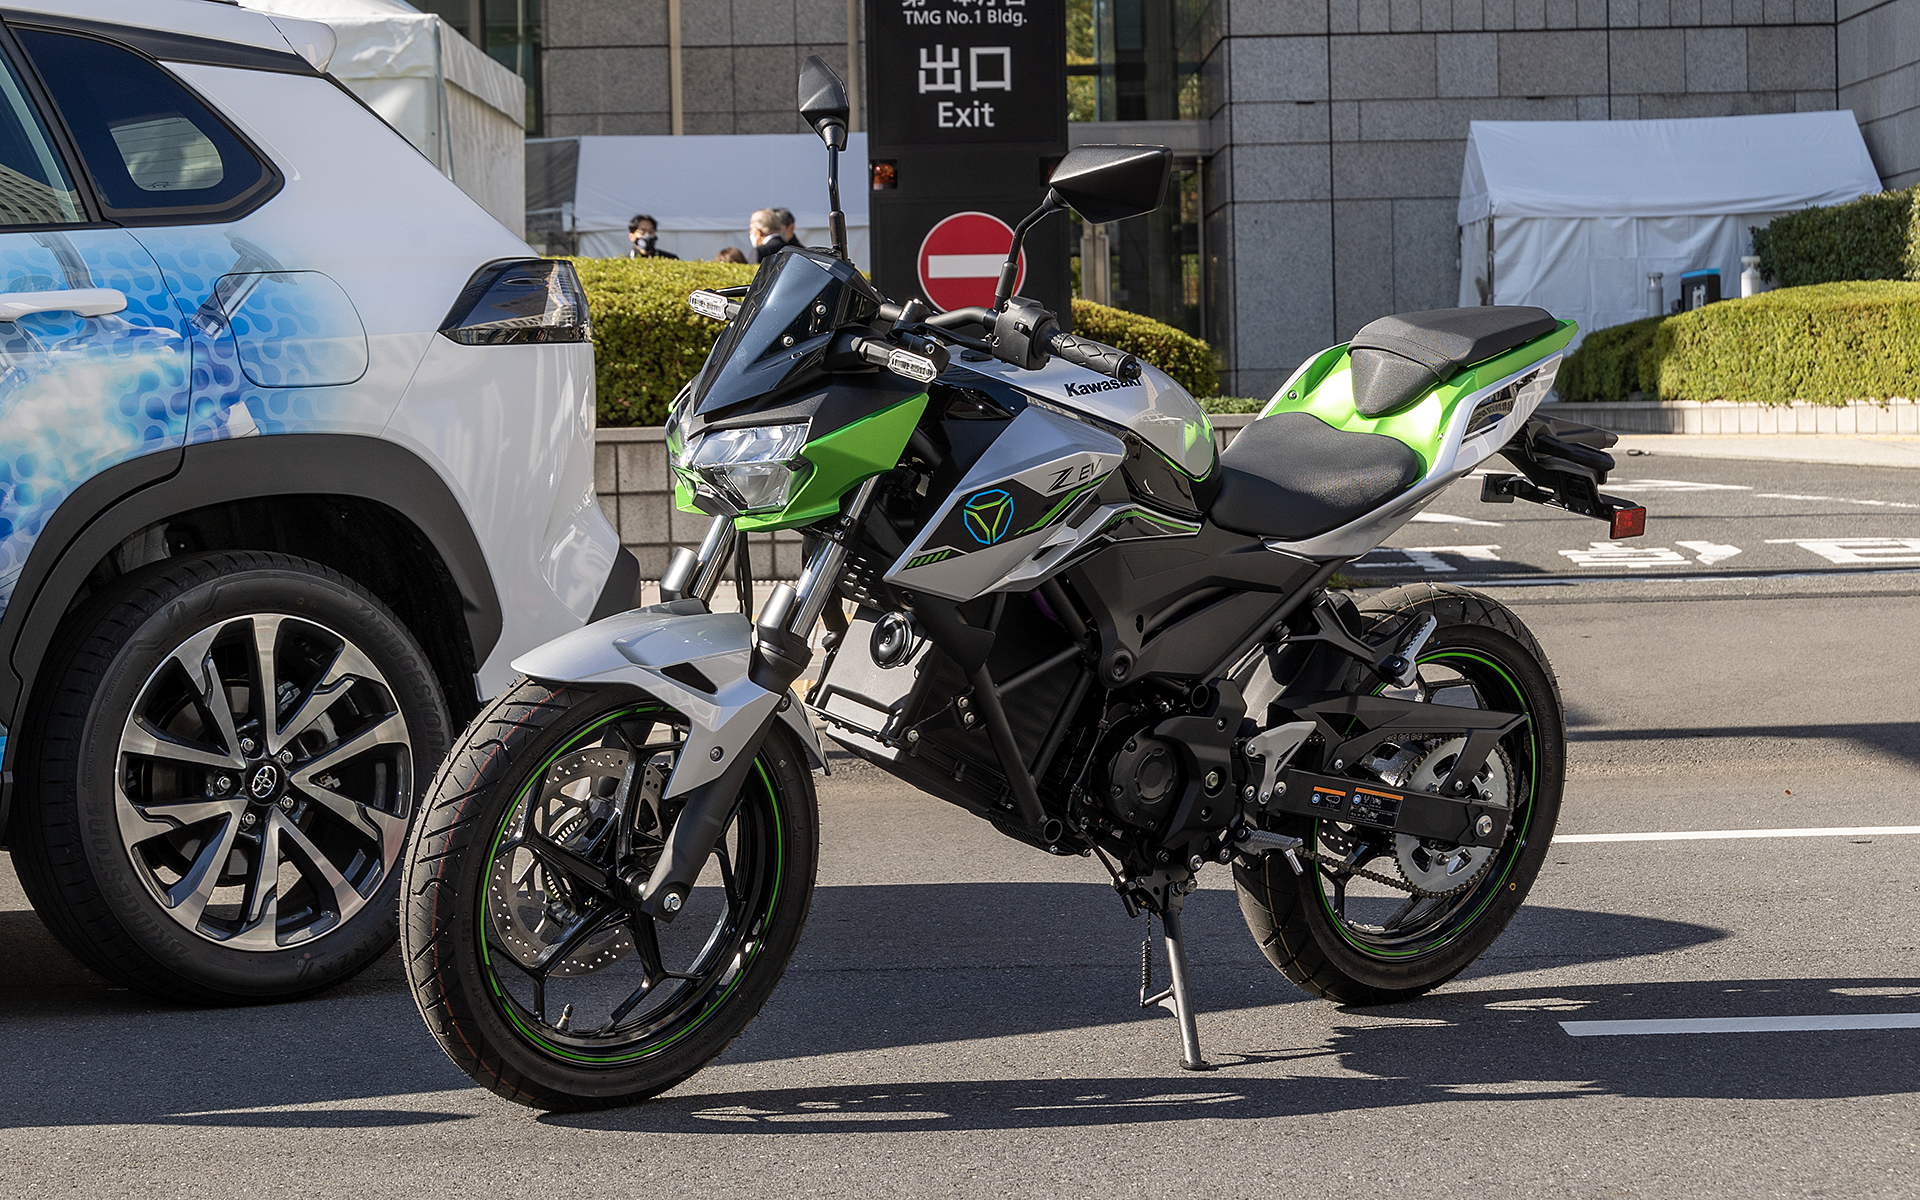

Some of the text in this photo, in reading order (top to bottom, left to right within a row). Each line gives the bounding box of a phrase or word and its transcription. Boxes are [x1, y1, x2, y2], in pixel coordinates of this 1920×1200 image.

[902, 8, 1027, 27] TMG No.1 Bldg.
[918, 44, 1012, 94] 出口
[938, 100, 995, 128] Exit
[1046, 458, 1103, 494] Z EV
[319, 917, 400, 976] LENZA
